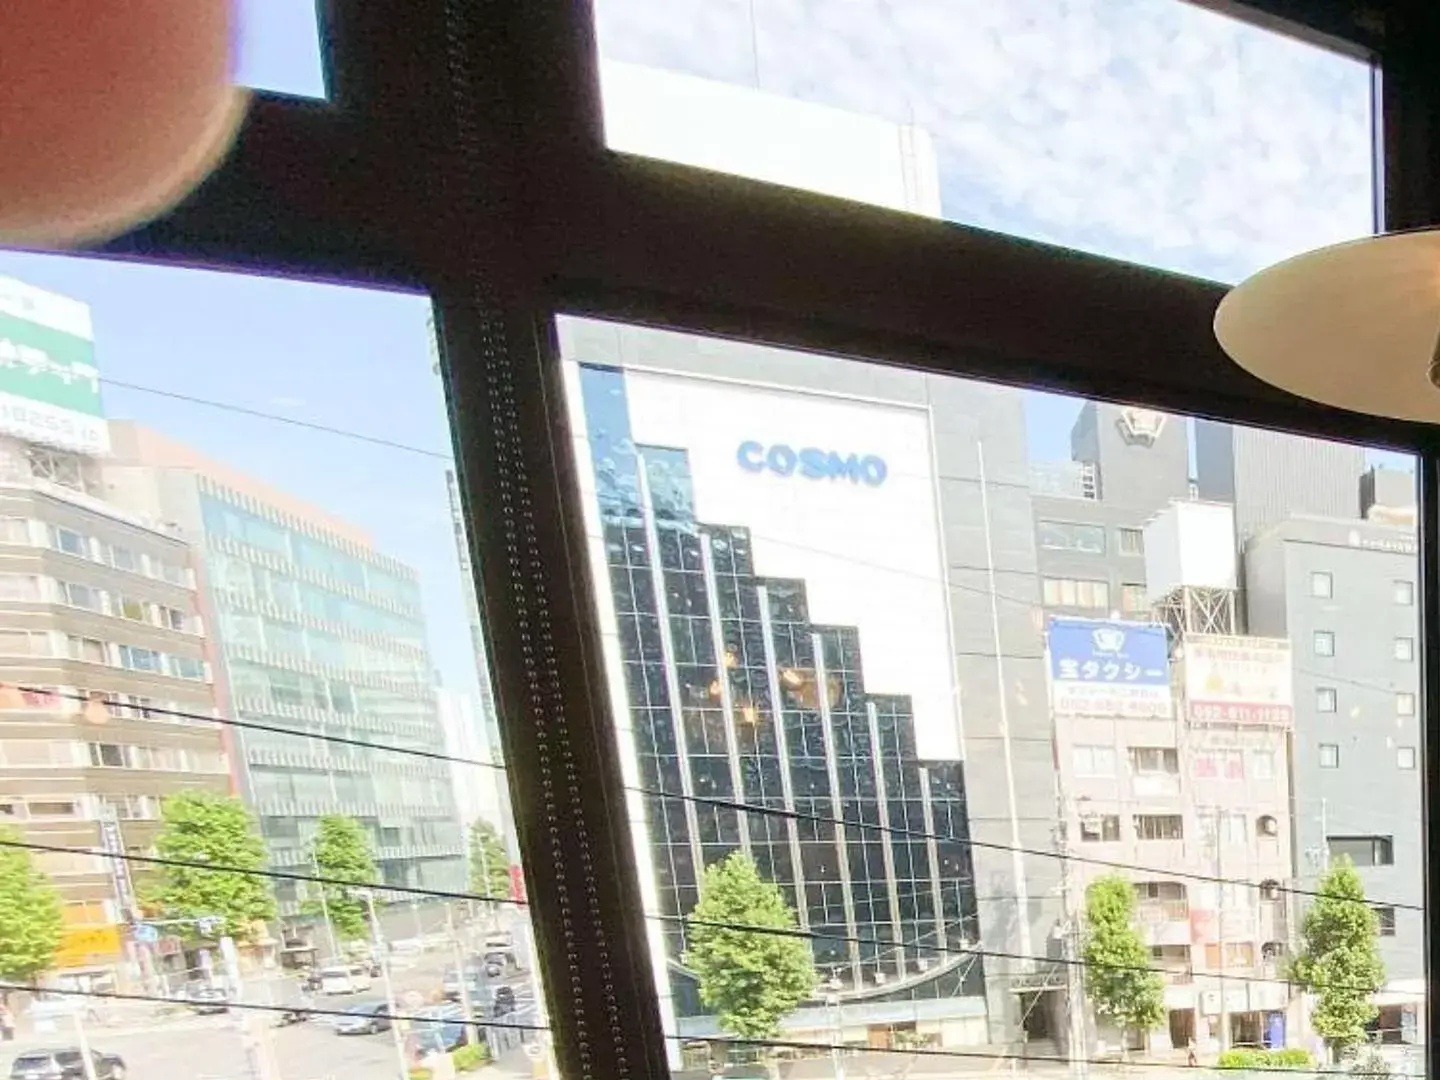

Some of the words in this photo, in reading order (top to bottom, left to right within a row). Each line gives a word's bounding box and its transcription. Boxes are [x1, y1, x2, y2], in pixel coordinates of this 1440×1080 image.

[736, 440, 888, 488] COSMO
[1059, 658, 1165, 681] 宝タクシー
